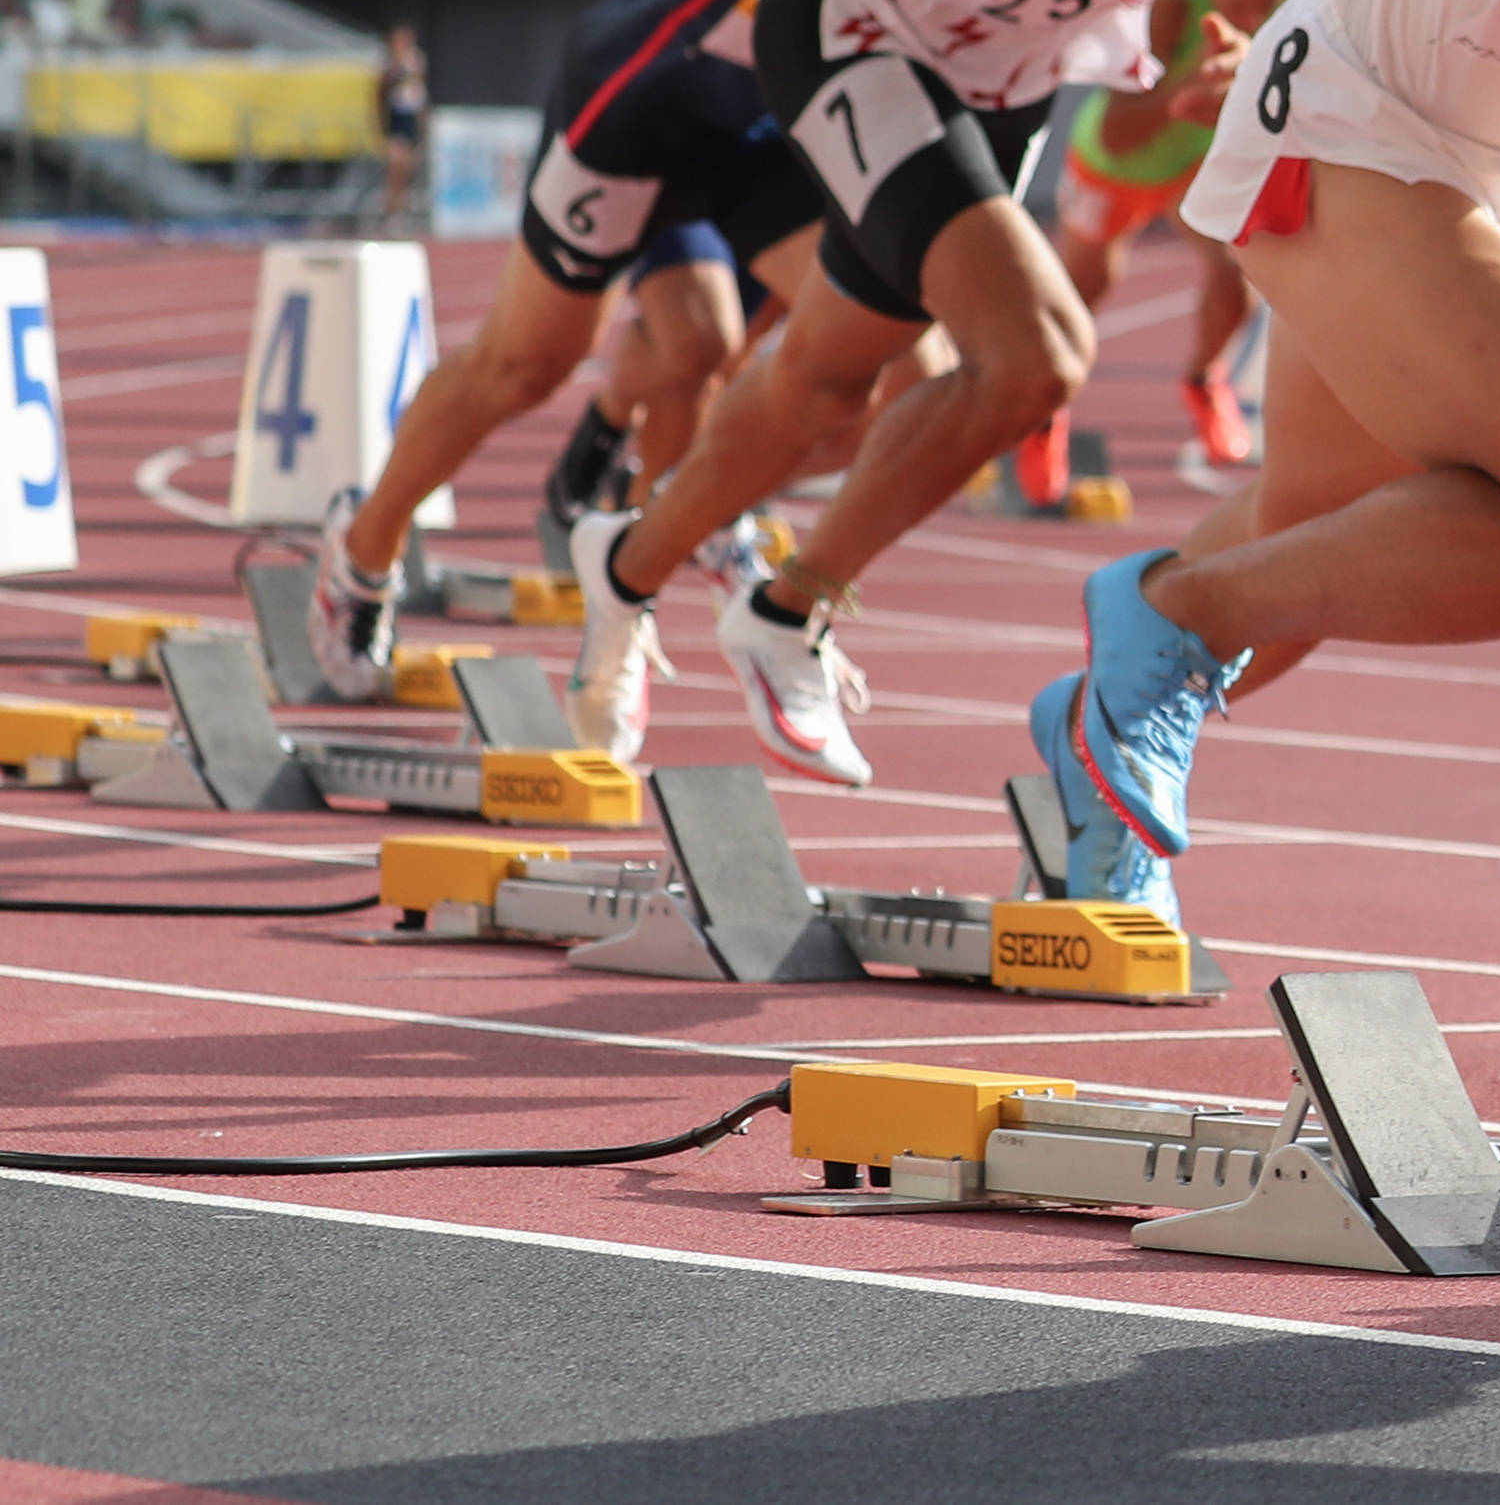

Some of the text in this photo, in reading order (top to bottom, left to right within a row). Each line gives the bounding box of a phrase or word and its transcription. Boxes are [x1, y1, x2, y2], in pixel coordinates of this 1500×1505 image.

[1257, 27, 1309, 134] 8
[825, 88, 868, 175] 7
[566, 188, 604, 236] 6
[7, 305, 60, 509] 5
[256, 290, 317, 473] 4
[487, 773, 563, 807] SEIKO
[998, 930, 1092, 971] SEIKO
